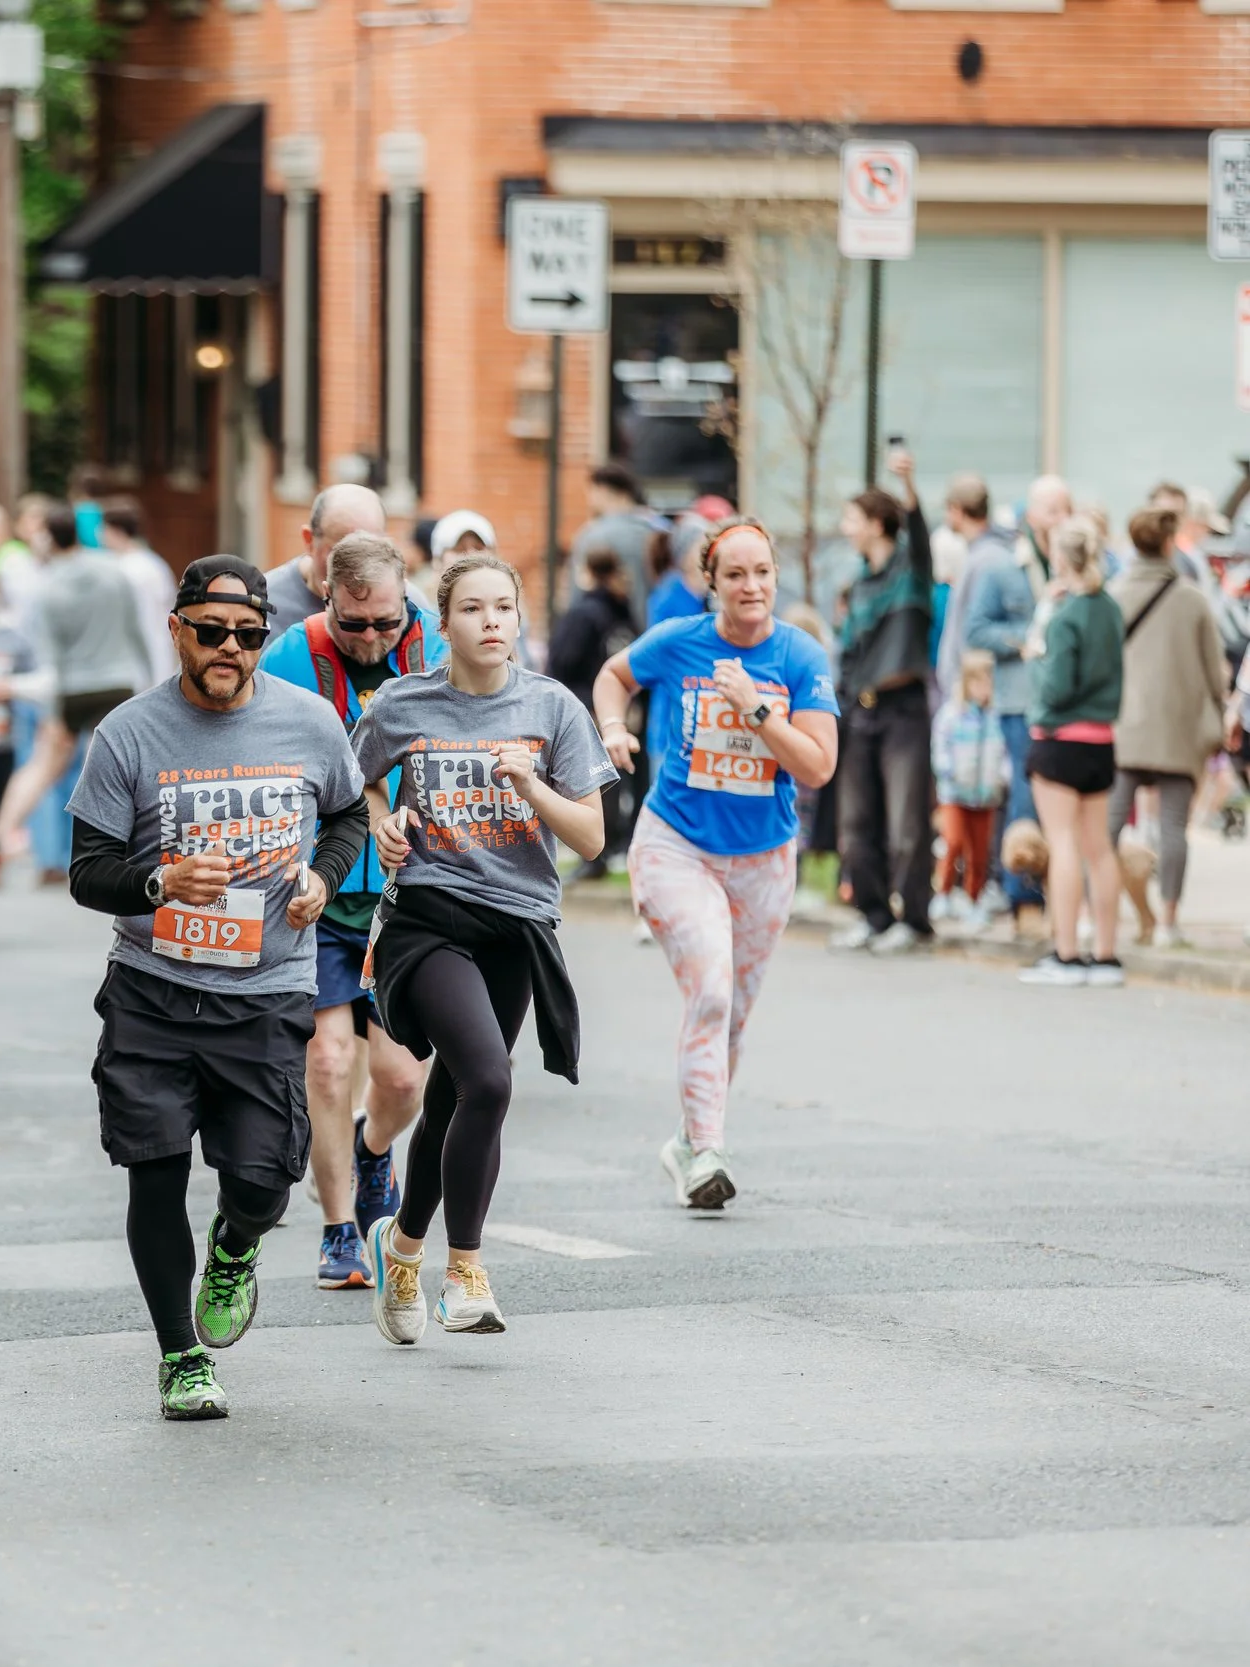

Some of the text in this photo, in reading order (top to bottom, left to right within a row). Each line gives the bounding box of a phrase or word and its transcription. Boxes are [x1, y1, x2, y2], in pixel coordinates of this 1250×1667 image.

[431, 738, 473, 750] Years
[158, 762, 303, 784] 28 Years Running!
[705, 753, 764, 780] 1401
[410, 753, 435, 819] ywca
[435, 786, 526, 809] again
[187, 811, 299, 842] against
[426, 823, 466, 840] APRIL
[469, 821, 497, 837] 25,
[174, 913, 241, 947] 1819
